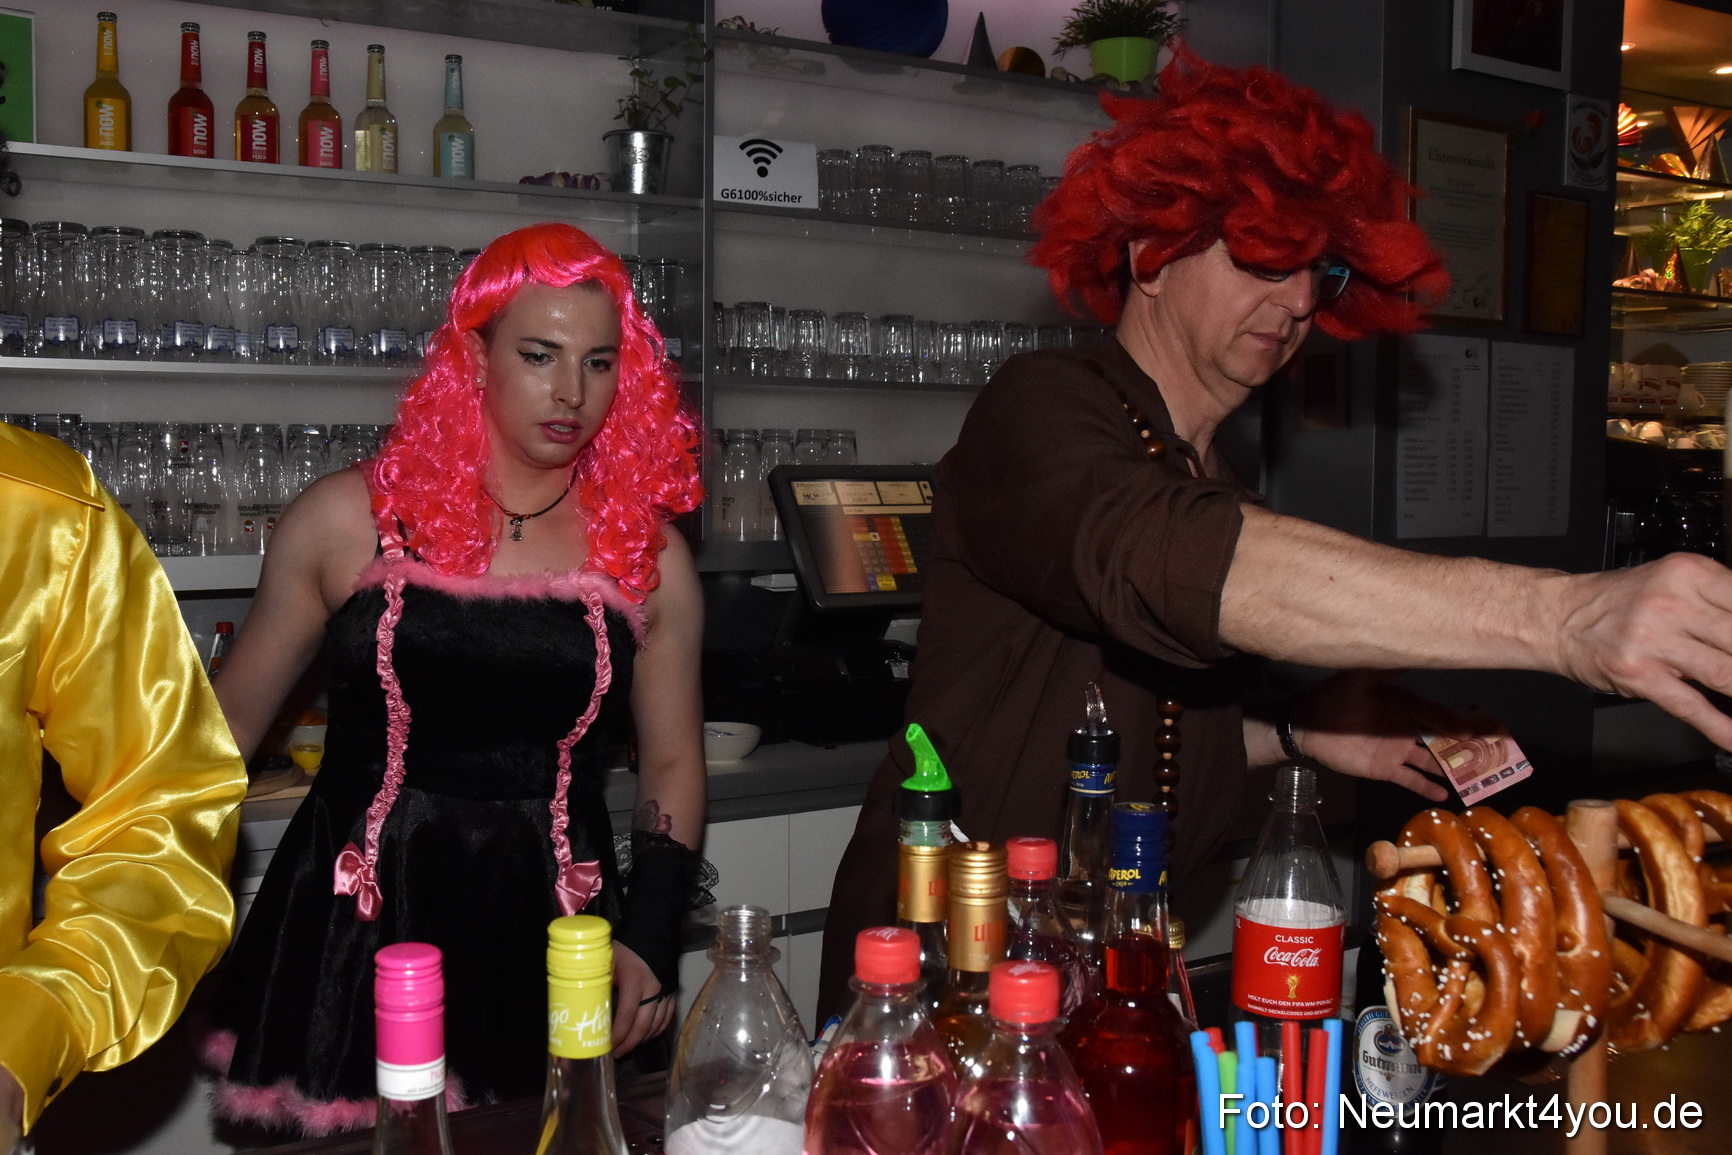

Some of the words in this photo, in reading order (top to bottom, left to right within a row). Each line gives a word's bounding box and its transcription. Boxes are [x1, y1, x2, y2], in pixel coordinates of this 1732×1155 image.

[191, 40, 199, 60] now
[254, 48, 264, 68] now
[320, 56, 328, 76] now
[99, 103, 114, 136] now
[194, 113, 207, 146] now
[252, 119, 267, 151] now
[320, 126, 334, 158] now
[382, 130, 394, 162] now
[451, 137, 465, 168] now
[721, 188, 803, 203] G6100%sicher
[1108, 867, 1142, 881] APEROL
[1275, 934, 1314, 944] CLASSIC
[1264, 946, 1322, 968] Coca-Cola
[1362, 1050, 1422, 1074] Gutmann
